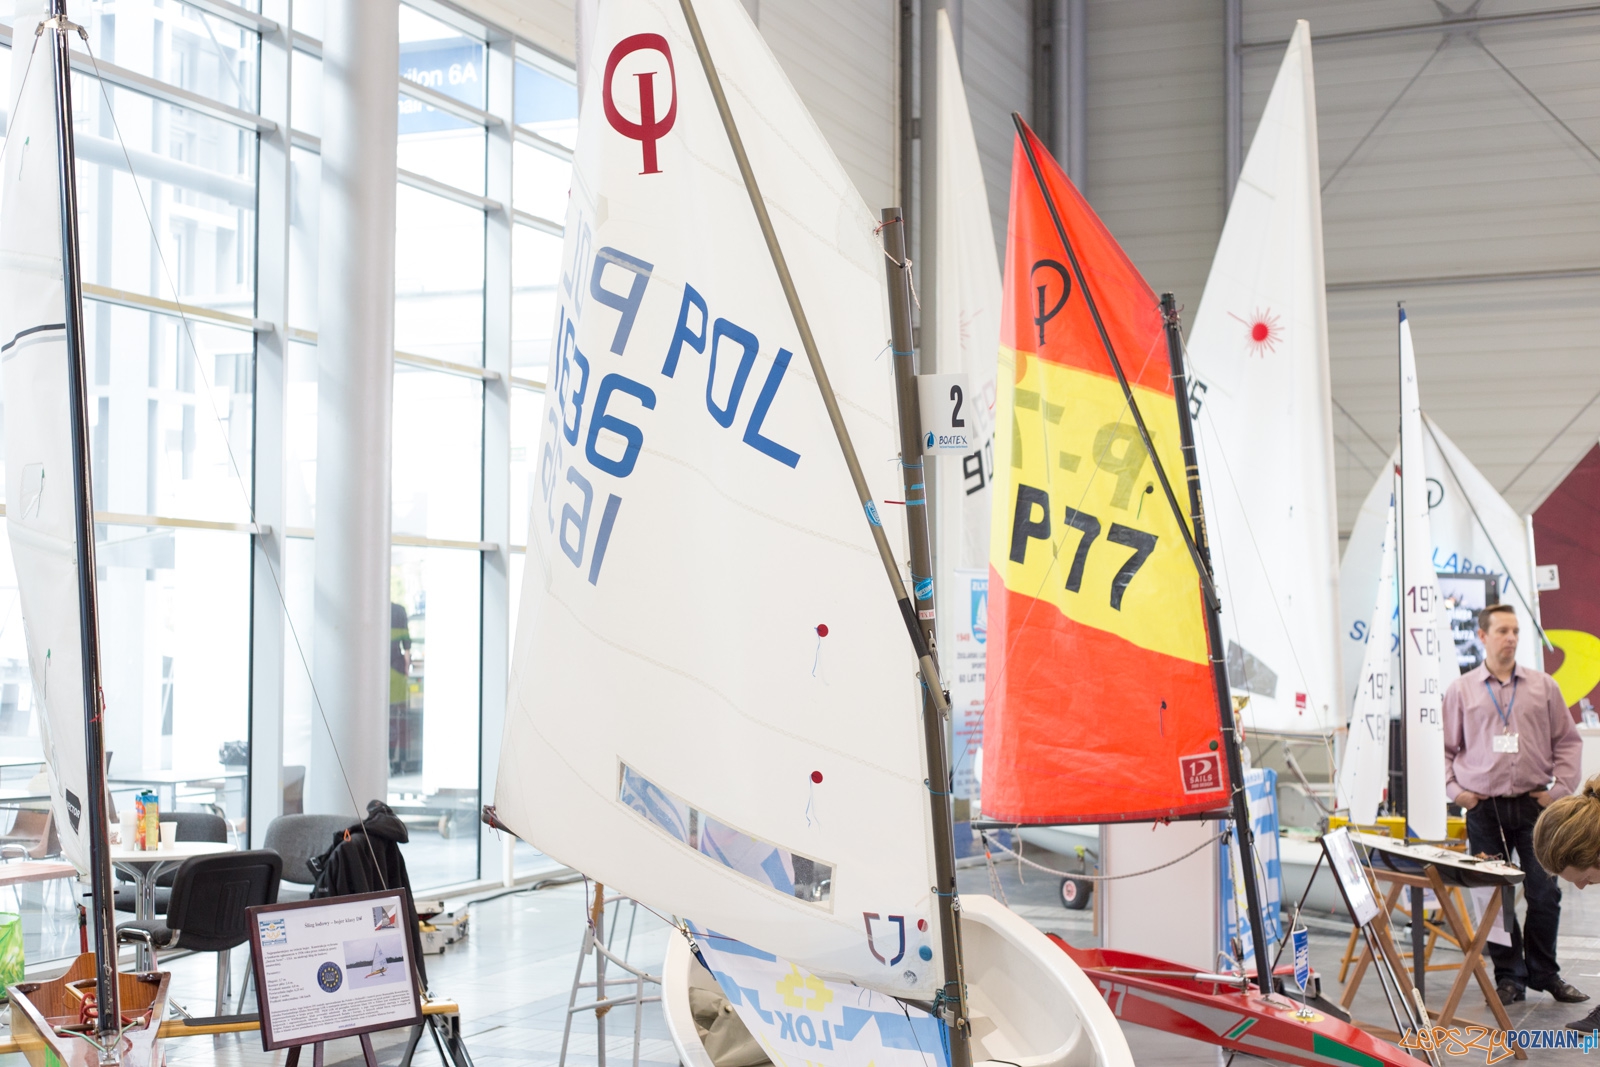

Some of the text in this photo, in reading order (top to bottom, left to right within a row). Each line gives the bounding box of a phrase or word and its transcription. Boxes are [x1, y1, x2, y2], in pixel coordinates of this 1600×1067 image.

[448, 61, 478, 86] 6A
[661, 282, 802, 470] POL
[554, 304, 657, 479] 1636
[949, 384, 965, 428] 2
[938, 434, 968, 446] BOATEX
[1548, 568, 1556, 582] 3
[1189, 773, 1213, 785] SAILS
